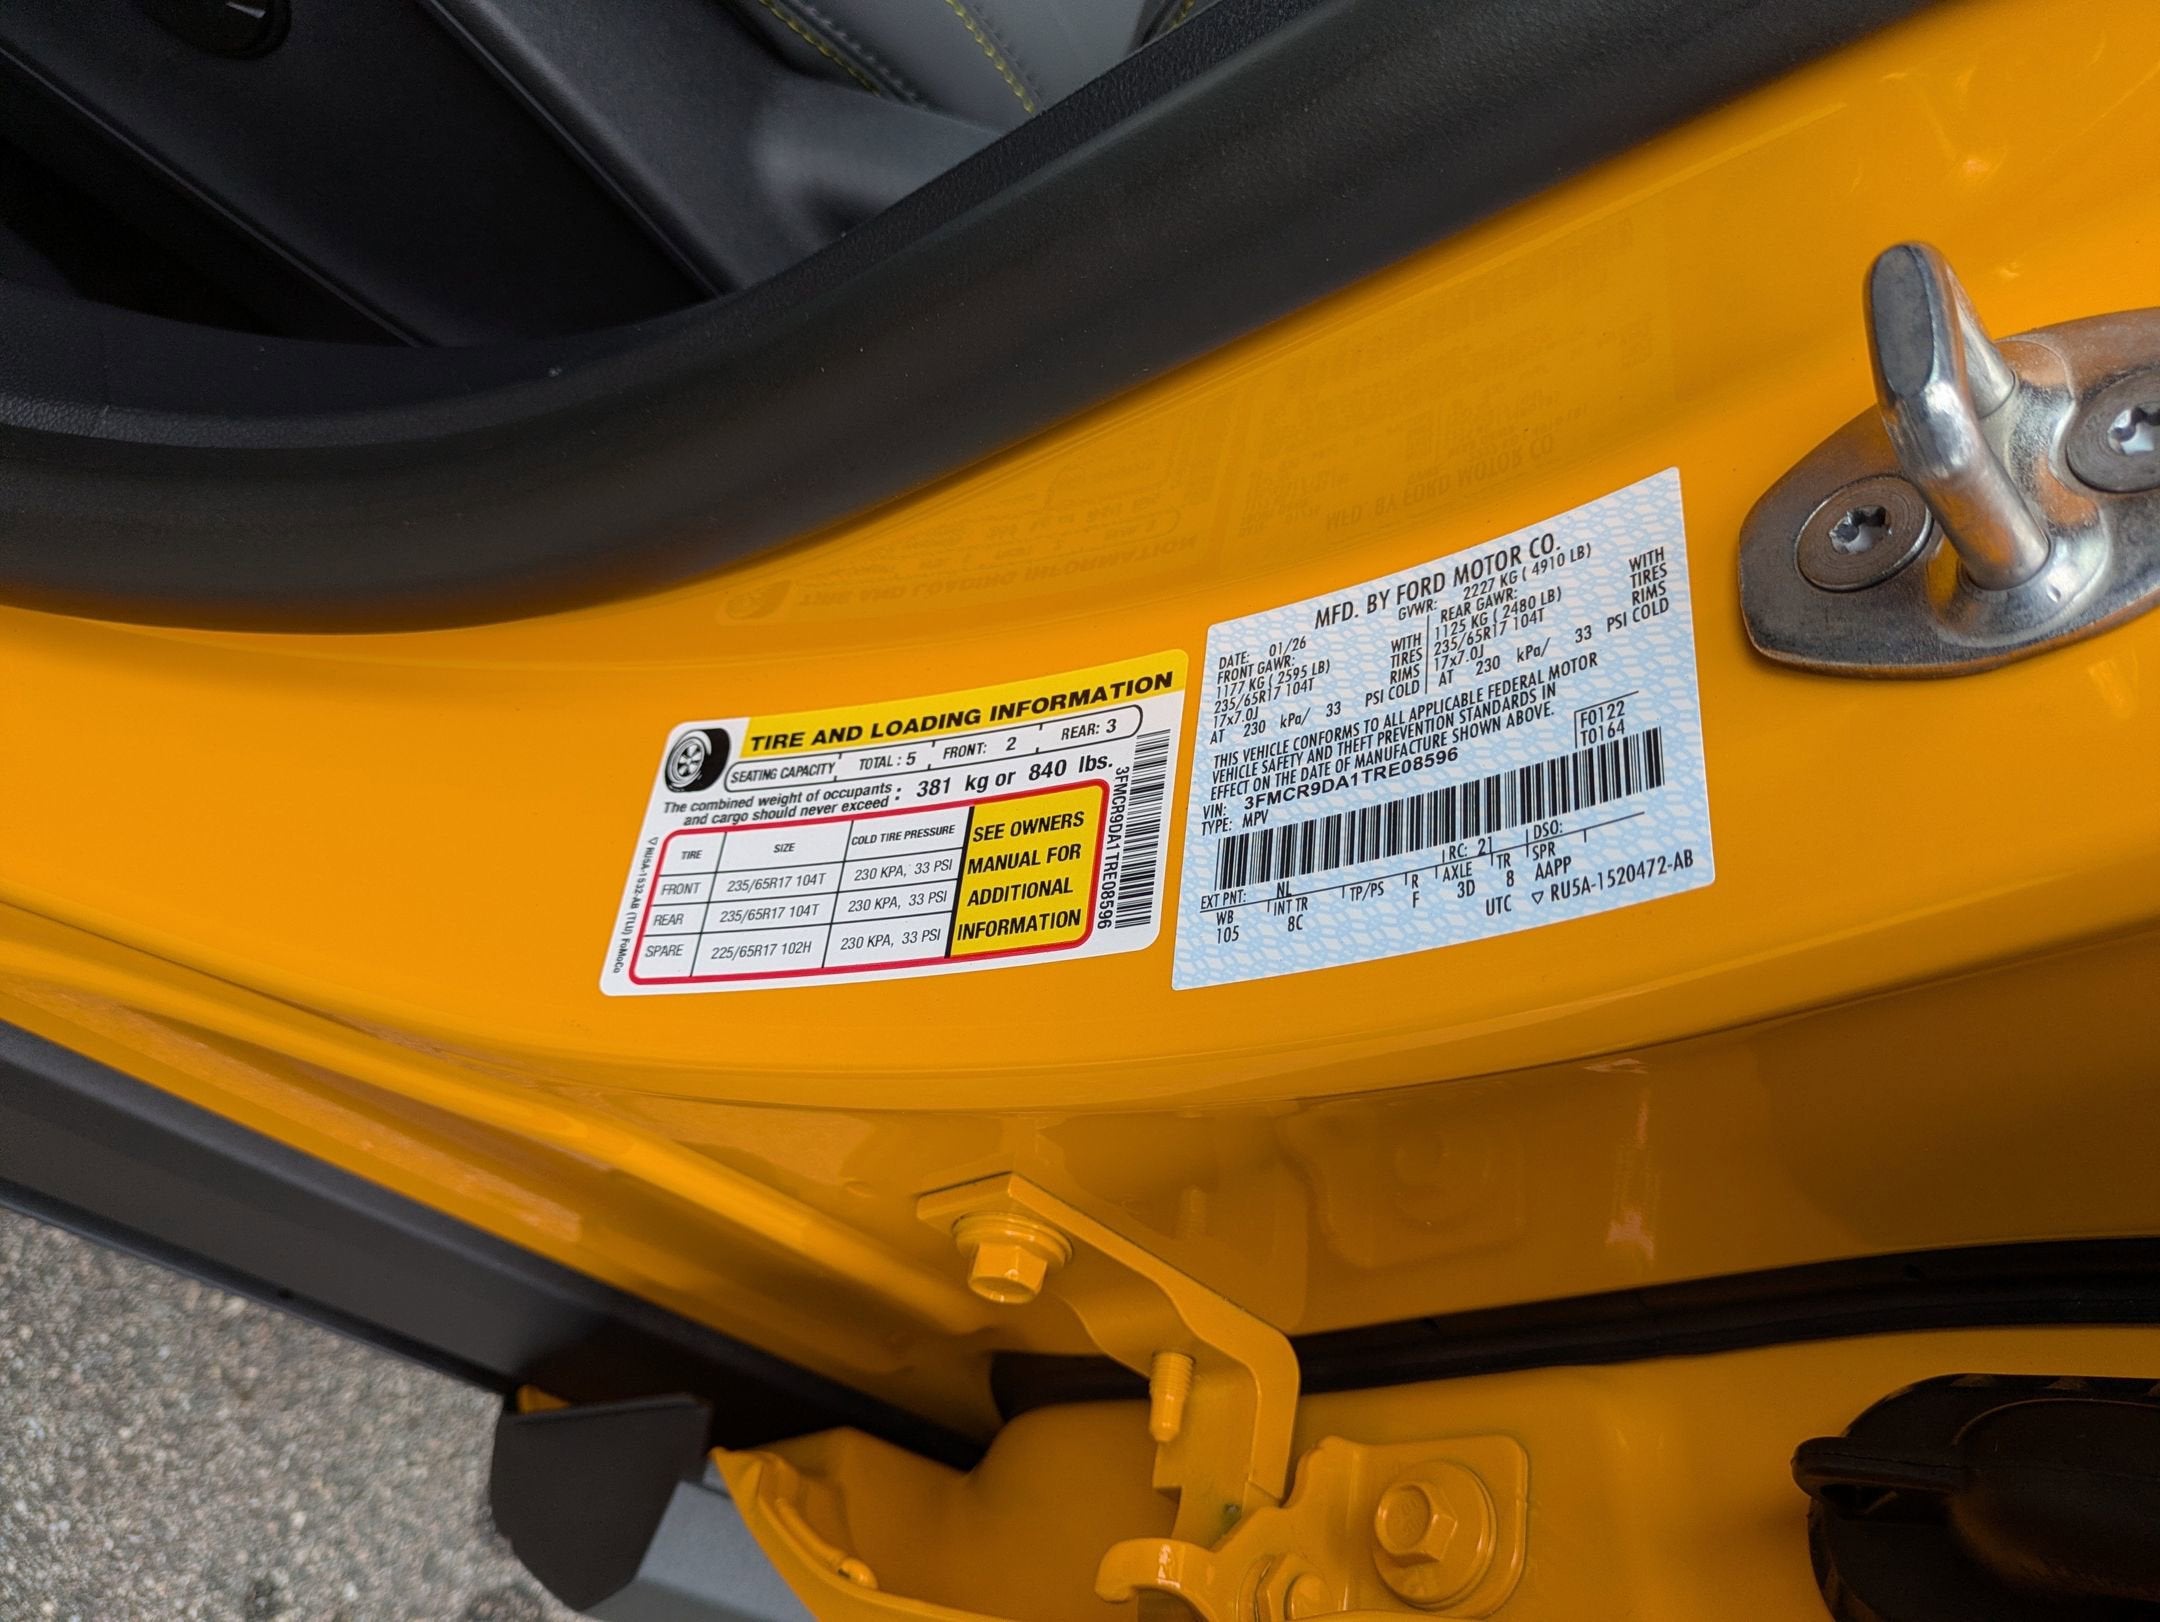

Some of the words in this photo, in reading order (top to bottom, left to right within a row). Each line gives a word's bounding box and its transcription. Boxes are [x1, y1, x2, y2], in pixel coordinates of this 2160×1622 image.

[1315, 601, 1358, 629] MFD.
[1367, 589, 1391, 614] BY
[1397, 572, 1445, 605] FORD
[1453, 545, 1522, 588] MOTOR
[1529, 532, 1561, 558] CO.
[1398, 598, 1438, 620] GVWR:
[1463, 577, 1496, 600] 2227
[1500, 570, 1518, 588] KG
[1570, 542, 1592, 563] LB)
[1435, 618, 1467, 639] 1125
[1471, 611, 1489, 630] KG
[1540, 586, 1562, 606] LB)
[1629, 546, 1665, 572] WITH
[1433, 621, 1507, 656] 235/65R17
[1513, 608, 1546, 630] 104T
[1630, 563, 1668, 589] TIRES
[1440, 601, 1471, 623] REAR
[1475, 588, 1518, 611] GAWR:
[1435, 645, 1484, 671] 17x7.0J
[1631, 581, 1667, 606] RIMS
[1219, 651, 1251, 670] DATE:
[1269, 636, 1307, 657] 01/26
[1438, 670, 1454, 687] AT
[1475, 655, 1501, 676] 230
[1516, 637, 1550, 663] kPa/
[1574, 625, 1593, 644] 33
[1606, 612, 1627, 633] PSI
[1632, 598, 1670, 623] COLD
[1217, 680, 1246, 699] 1177
[1249, 676, 1265, 692] KG
[1312, 659, 1330, 675] LB)
[1391, 632, 1422, 653] WITH
[1217, 664, 1254, 685] FRONT
[1257, 655, 1295, 675] GAWR:
[1214, 686, 1281, 714] 235/65R17
[1287, 677, 1315, 696] 104T
[1390, 647, 1423, 669] TIRES
[1213, 706, 1259, 729] 17x7.0J
[1390, 663, 1420, 685] RIMS
[751, 732, 805, 751] TIRE
[812, 726, 863, 744] AND
[870, 709, 981, 738] LOADING
[990, 671, 1173, 721] INFORMATION
[1210, 729, 1225, 745] AT
[1243, 720, 1266, 737] 230
[1280, 707, 1310, 728] kPa/
[1326, 701, 1342, 717] 33
[1365, 689, 1384, 707] PSI
[1388, 680, 1420, 701] COLD
[1214, 751, 1238, 769] THIS
[1243, 739, 1289, 762] VEHICLE
[1293, 722, 1360, 751] CONFORMS
[1363, 718, 1379, 734] TO
[1383, 711, 1405, 728] ALL
[1409, 687, 1484, 723] APPLICABLE
[1488, 669, 1544, 700] FEDERAL
[1548, 652, 1598, 681] MOTOR
[1061, 723, 1100, 741] REAR:
[1105, 718, 1117, 734] 3
[1212, 762, 1258, 784] VEHICLE
[1262, 753, 1302, 775] SAFETY
[1306, 745, 1332, 764] AND
[1338, 734, 1373, 757] THEFT
[1377, 711, 1454, 750] PREVENTION
[1459, 688, 1537, 725] STANDARDS
[1542, 682, 1557, 699] IN
[905, 751, 917, 766] 5
[943, 743, 987, 760] FRONT:
[1006, 737, 1017, 752] 2
[1210, 780, 1248, 801] EFFECT
[1253, 775, 1270, 793] ON
[1276, 769, 1296, 787] THE
[1300, 762, 1331, 782] DATE
[1335, 757, 1351, 773] OF
[1355, 730, 1447, 769] MANUFACTURE
[1452, 717, 1501, 744] SHOWN
[1506, 701, 1555, 729] ABOVE.
[730, 766, 777, 784] SEATING
[780, 761, 836, 780] CAPACITY
[916, 777, 951, 798] 381
[964, 773, 989, 793] kg
[995, 770, 1016, 786] or
[1028, 759, 1067, 782] 840
[1078, 754, 1113, 774] lbs.
[1202, 804, 1227, 820] VIN:
[1244, 747, 1458, 810] 3FMCR9DA1TRE08596
[664, 801, 687, 814] The
[690, 794, 754, 812] combined
[758, 791, 802, 808] weight
[806, 789, 820, 802] of
[823, 782, 892, 802] occupants
[683, 815, 707, 826] and
[709, 812, 748, 826] cargo
[752, 806, 796, 821] should
[800, 804, 837, 816] never
[842, 795, 890, 812] exceed
[851, 833, 877, 845] COLD
[880, 830, 902, 843] TIRE
[904, 825, 956, 840] PRESSURE
[973, 823, 1005, 842] SEE
[1010, 811, 1085, 837] OWNERS
[1201, 817, 1233, 836] TYPE:
[1242, 809, 1269, 828] MPV
[1534, 820, 1563, 840] DSO:
[681, 850, 702, 860] TIRE
[773, 842, 795, 853] SIZE
[967, 850, 1041, 875] MANUAL
[1046, 843, 1082, 862] FOR
[1097, 766, 1129, 929] 3FMCR9DA1TRE08596
[1449, 843, 1468, 860] RC:
[1532, 841, 1556, 861] SPR
[854, 868, 877, 881] 230
[880, 865, 907, 879] KPA,
[914, 862, 930, 875] 33
[934, 859, 953, 872] PSI
[1442, 861, 1473, 882] AXLE
[1496, 853, 1511, 870] TR
[1534, 855, 1573, 881] AAPP
[660, 882, 701, 896] FRONT
[726, 877, 792, 896] 235/65R17
[796, 872, 827, 887] 104T
[1457, 879, 1476, 899] 3D
[1550, 849, 1694, 902] RU5A-1520472-AB
[848, 899, 871, 912] 230
[874, 896, 901, 910] KPA,
[908, 893, 924, 906] 33
[928, 890, 947, 904] PSI
[967, 877, 1073, 907] ADDITIONAL
[1200, 894, 1221, 910] EXT
[1222, 889, 1247, 906] PNT:
[1276, 881, 1292, 899] NL
[1350, 881, 1385, 901] TP/PS
[719, 906, 785, 924] 235/65R17
[789, 903, 820, 917] 104T
[1216, 910, 1234, 925] WB
[1273, 900, 1292, 916] INT
[1296, 897, 1308, 912] TR
[1485, 894, 1512, 916] UTC
[653, 913, 683, 926] REAR
[957, 908, 1081, 941] INFORMATION
[1287, 914, 1304, 932] 8C
[840, 936, 864, 950] 230
[867, 934, 894, 948] KPA,
[902, 931, 918, 944] 33
[921, 928, 941, 942] PSI
[1217, 925, 1240, 944] 105
[613, 938, 630, 973] FoMoCo
[645, 944, 684, 957] SPARE
[711, 943, 777, 961] 225/65R17
[781, 941, 812, 955] 102H
